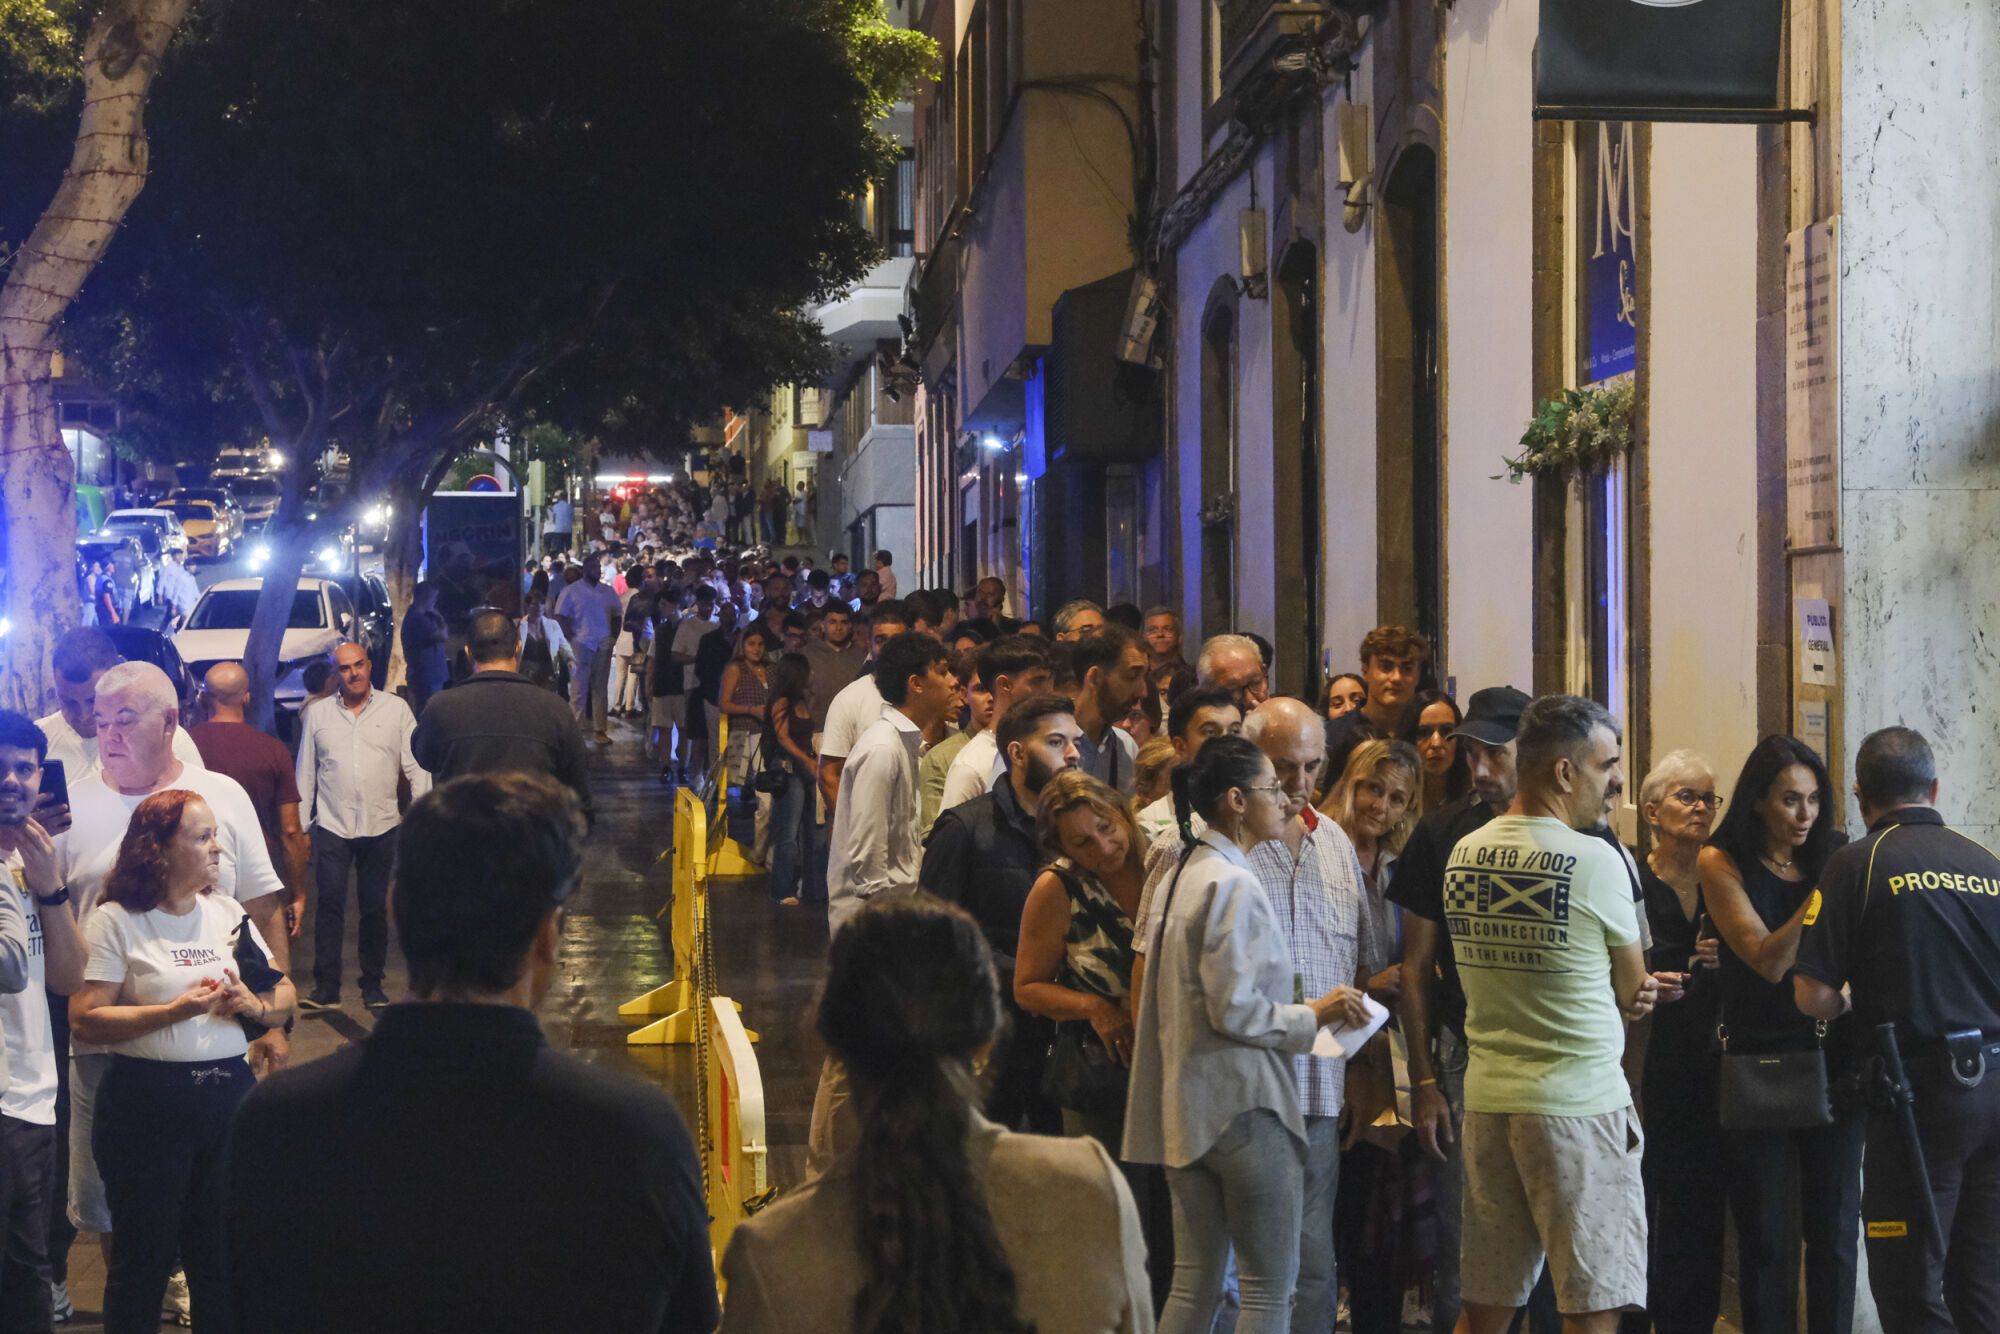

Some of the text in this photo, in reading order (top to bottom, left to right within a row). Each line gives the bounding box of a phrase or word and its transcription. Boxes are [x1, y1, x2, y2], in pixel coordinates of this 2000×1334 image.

[1888, 871, 2000, 896] PROSEGU
[1474, 921, 1568, 943] CONNECTION
[170, 948, 215, 960] TOMMY
[193, 956, 222, 967] JEANS
[1464, 946, 1541, 964] TO THE HEART
